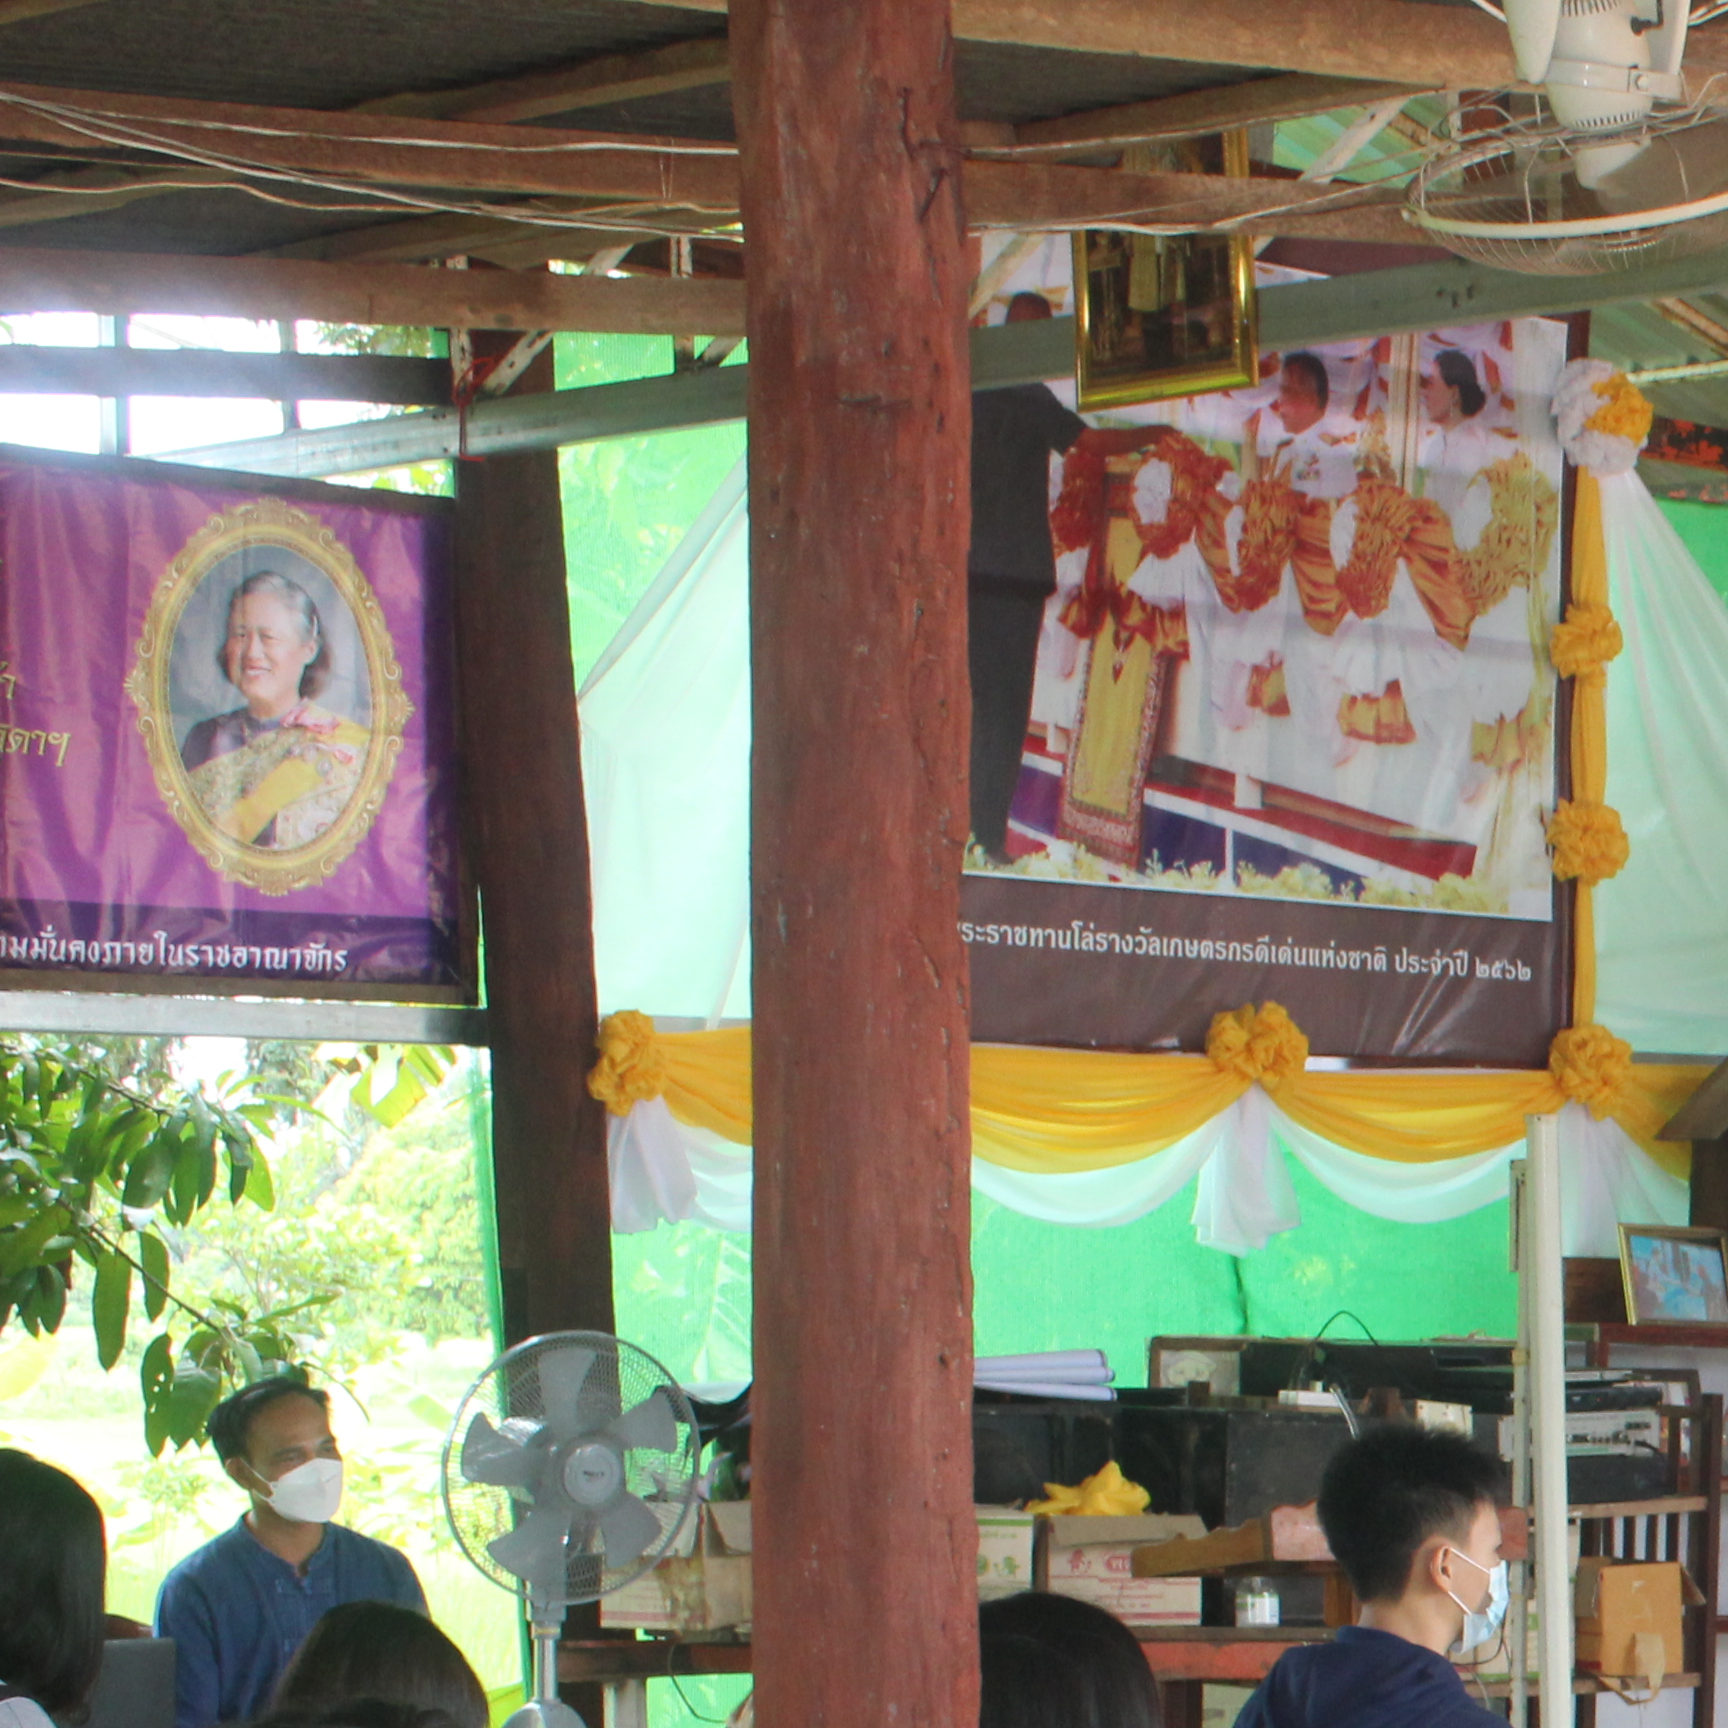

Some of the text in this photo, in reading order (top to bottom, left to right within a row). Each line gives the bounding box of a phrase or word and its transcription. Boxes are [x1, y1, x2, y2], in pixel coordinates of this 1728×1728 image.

[956, 919, 1532, 983] ระราชทานโล่รางวัลเกษตรกรดีเด่นแห่งชาติ ประจำปี ๒๕๖๒
